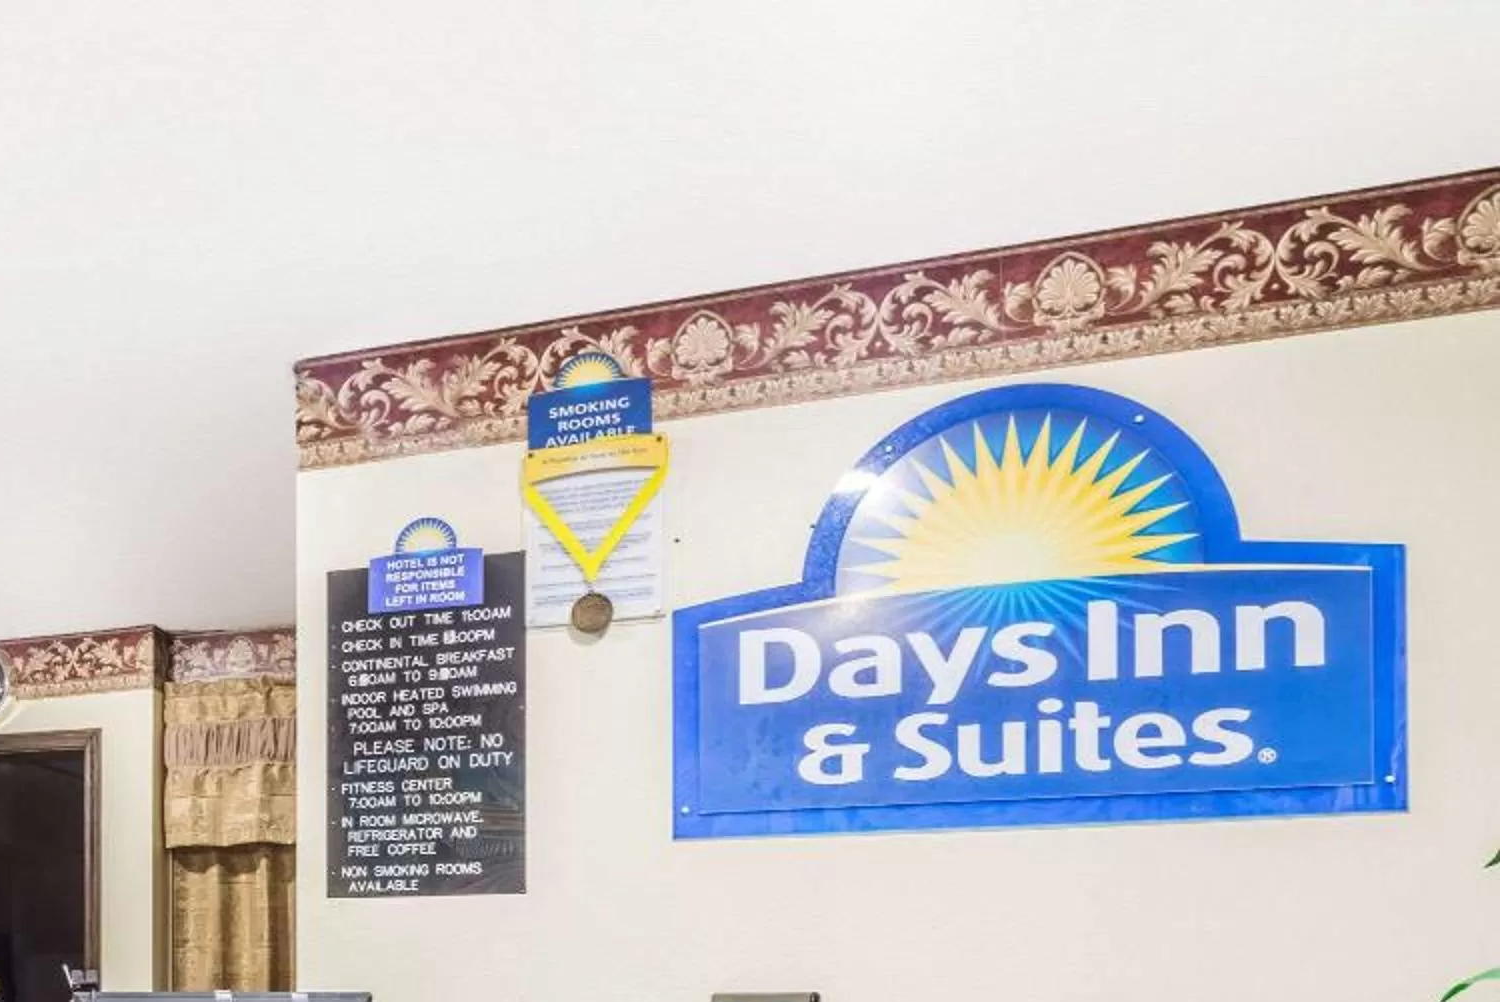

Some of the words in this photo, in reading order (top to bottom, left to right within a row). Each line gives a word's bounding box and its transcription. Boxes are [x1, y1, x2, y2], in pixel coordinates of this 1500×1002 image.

[548, 397, 630, 419] SMOKING
[558, 412, 621, 432] ROOMS
[387, 559, 424, 570] HOTEL
[427, 557, 437, 566] IS
[440, 554, 464, 565] NOT
[385, 566, 465, 582] RESPONSIBLE
[396, 583, 419, 593] FOR
[421, 579, 456, 591] ITEMS
[385, 595, 412, 606] LEFT
[416, 594, 426, 604] IN
[430, 591, 465, 603] ROOM
[342, 618, 382, 632] CHECK
[390, 616, 416, 628] OUT
[424, 612, 453, 625] TIME
[462, 606, 512, 622] 11:00AM
[342, 638, 383, 652] CHECK
[390, 637, 402, 648] IN
[409, 634, 438, 646] TIME
[342, 655, 428, 672] CONTINENTAL
[436, 647, 515, 664] BREAKFAST
[739, 619, 1058, 706] Days
[1087, 599, 1325, 682] Inn
[404, 670, 421, 682] TO
[342, 692, 386, 705] INDOOR
[394, 687, 444, 702] HEATED
[452, 681, 517, 698] SWIMMING
[348, 707, 382, 720] POOL
[390, 705, 415, 716] AND
[423, 702, 448, 714] SPA
[348, 721, 396, 734] 7:00AM
[404, 719, 421, 731] TO
[429, 715, 482, 729] 10:00PM
[353, 739, 415, 756] PLEASE
[423, 735, 472, 750] NOTE:
[480, 733, 503, 748] NO
[798, 723, 871, 785] &
[893, 698, 1254, 781] Suites
[343, 757, 429, 774] LIFEGUARD
[438, 755, 461, 769] ON
[469, 751, 513, 768] DUTY
[342, 781, 394, 795] FITNESS
[402, 778, 452, 791] CENTER
[348, 796, 396, 809] 7:00AM
[404, 795, 421, 806] TO
[429, 792, 483, 805] 10:00PM
[342, 816, 352, 828] IN
[360, 814, 396, 826] ROOM
[348, 828, 443, 843] REFRIGERATOR
[451, 826, 477, 838] AND
[348, 844, 379, 857] FREE
[387, 842, 437, 855] COFFEE
[341, 866, 367, 878] NON
[373, 863, 429, 877] SMOKING
[436, 861, 483, 875] ROOMS
[348, 879, 420, 892] AVAILABLE
